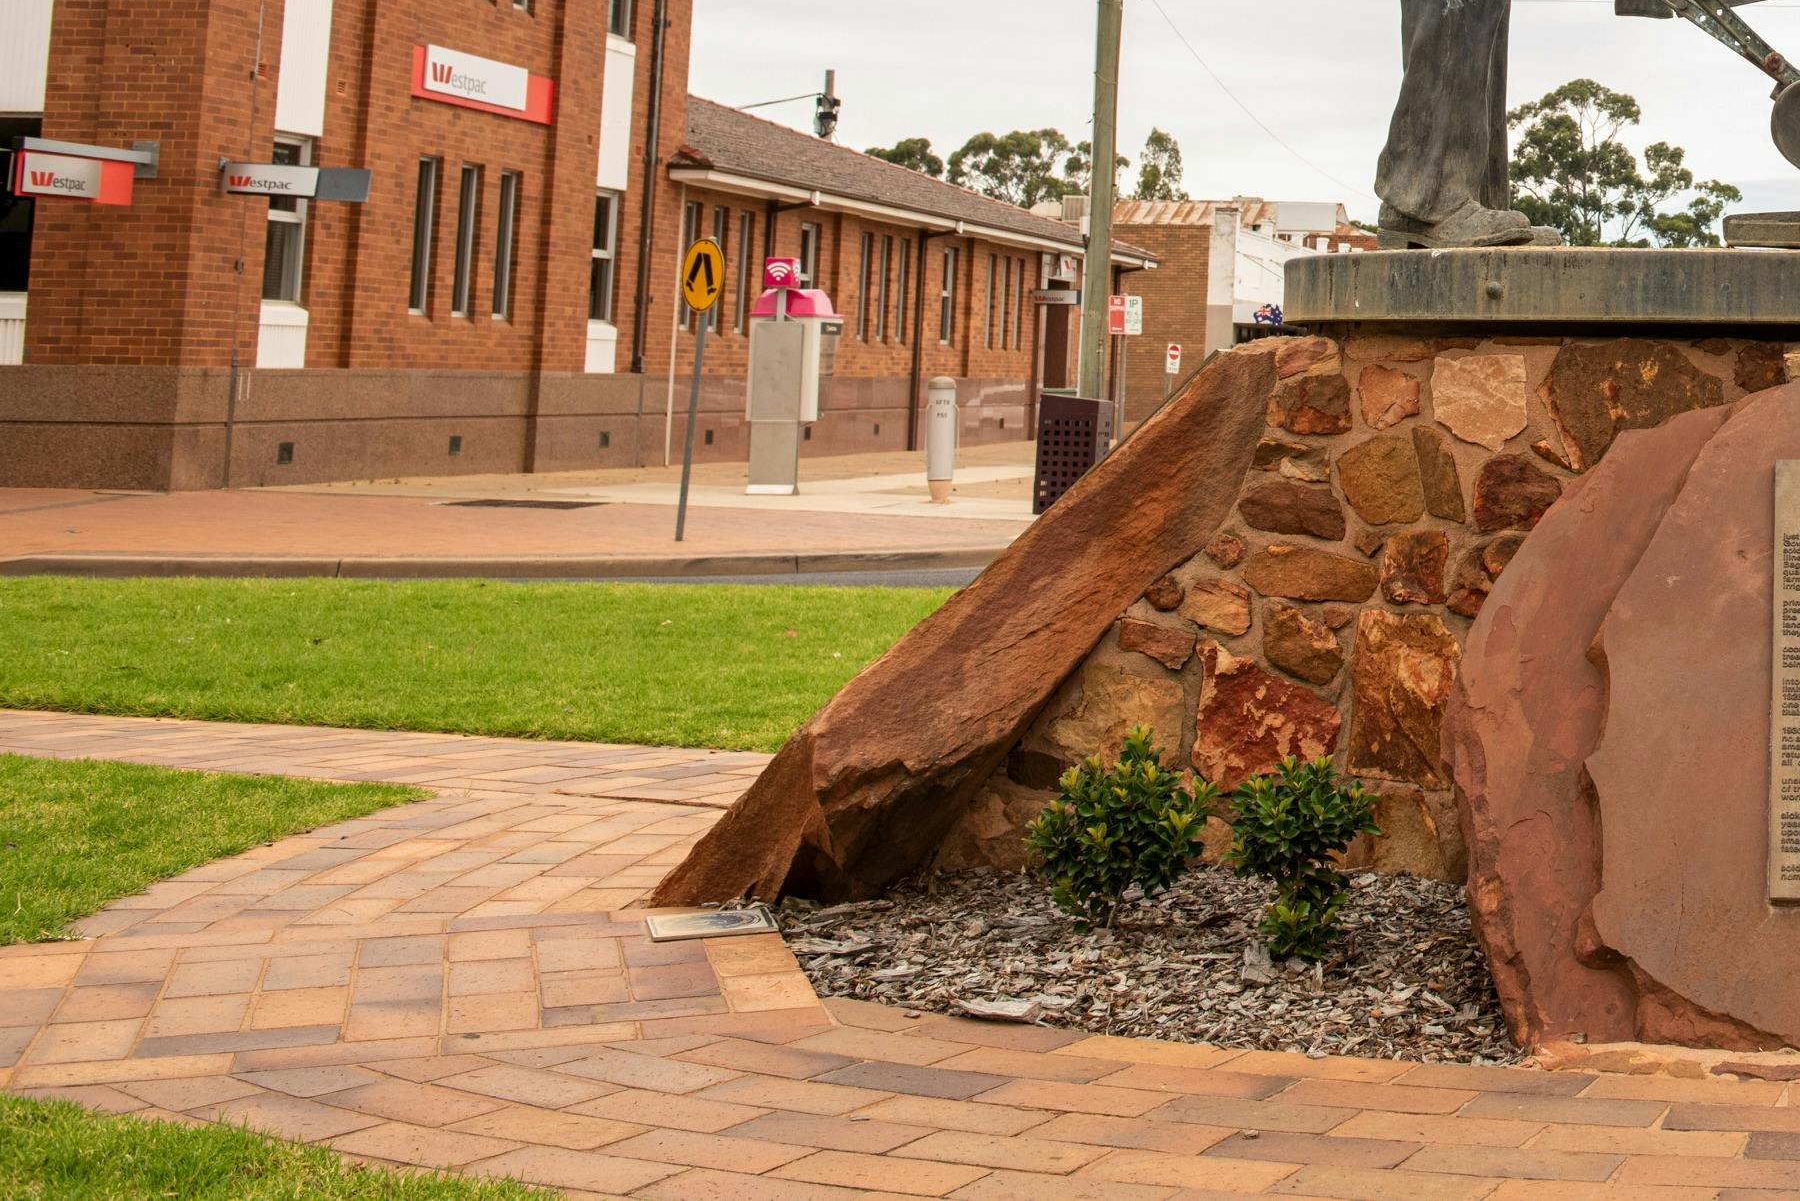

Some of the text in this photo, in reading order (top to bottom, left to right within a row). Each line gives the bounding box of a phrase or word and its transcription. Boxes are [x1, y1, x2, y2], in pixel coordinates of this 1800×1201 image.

[432, 61, 487, 95] Westpac
[31, 171, 86, 192] Westpac
[229, 175, 293, 191] Westpac
[1782, 678, 1800, 686] into
